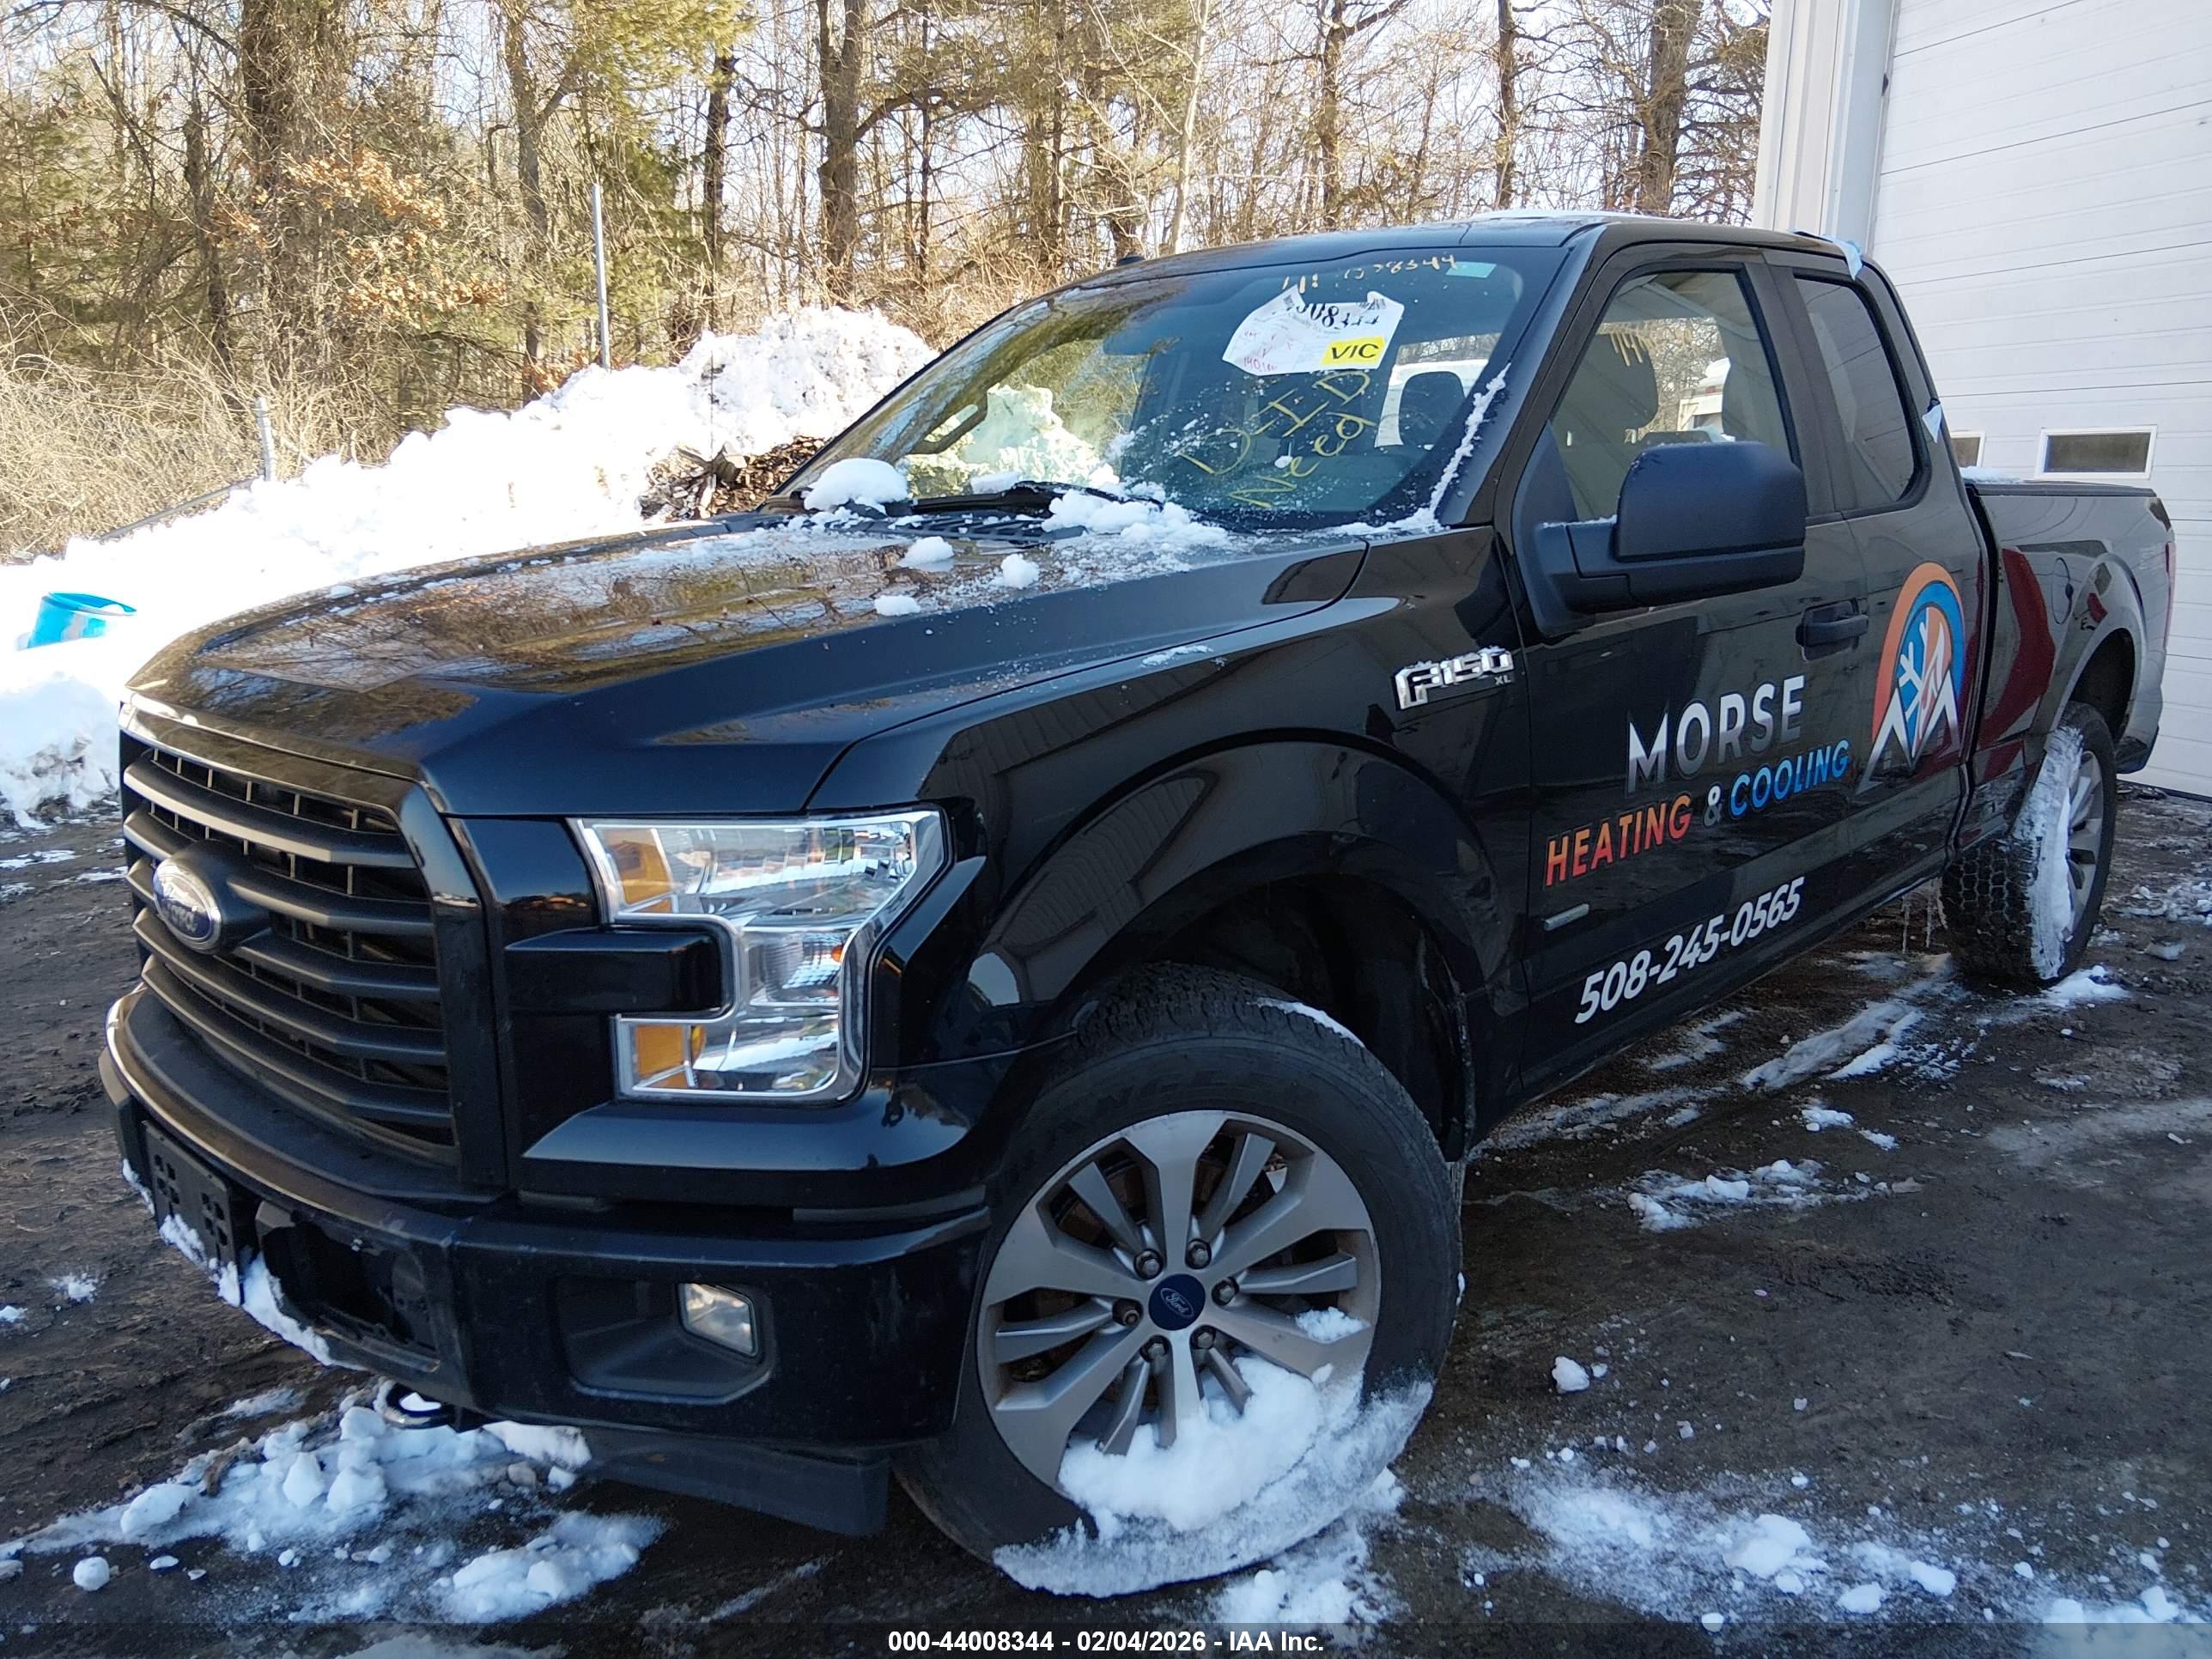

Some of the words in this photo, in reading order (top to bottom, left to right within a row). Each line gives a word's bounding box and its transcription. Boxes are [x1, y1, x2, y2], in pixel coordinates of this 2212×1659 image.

[1332, 343, 1378, 359] VIC
[1627, 674, 1805, 794] MORSE
[1545, 793, 1692, 887] HEATING
[1703, 784, 1723, 827] &
[1729, 738, 1850, 817] COOLING
[1574, 876, 1806, 1024] 508-245-0565
